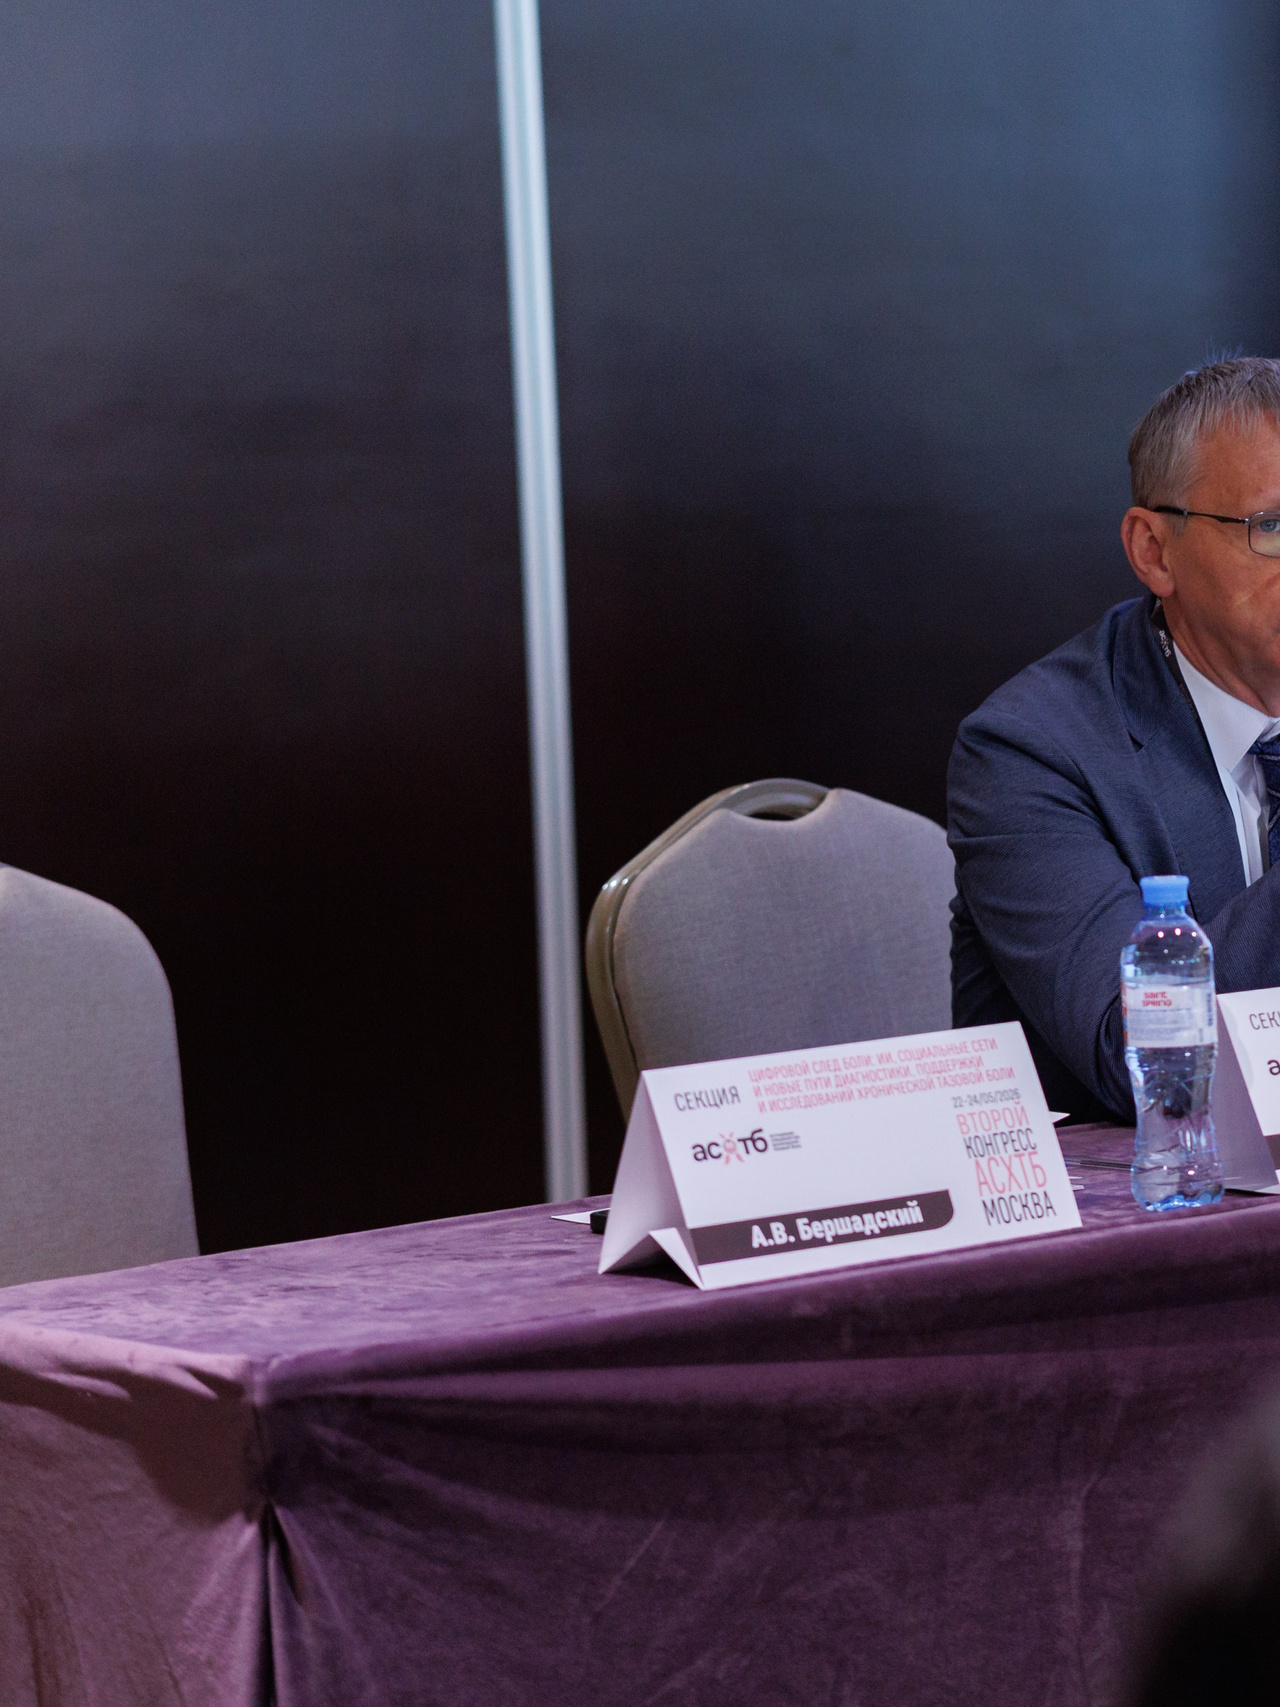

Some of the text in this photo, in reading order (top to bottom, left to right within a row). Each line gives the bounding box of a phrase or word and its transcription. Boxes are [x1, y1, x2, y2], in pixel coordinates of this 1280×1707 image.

[748, 1060, 810, 1082] ЦИФРОВОЙ
[812, 1058, 841, 1074] СЛЕД
[897, 1041, 969, 1062] СОЦИАЛЬНЫЕ
[971, 1037, 998, 1052] СЕТИ
[753, 1085, 762, 1097] И
[765, 1080, 801, 1096] НОВЫЕ
[804, 1076, 832, 1091] ПУТИ
[916, 1055, 984, 1075] ПОДДЕРЖКИ
[674, 1086, 741, 1112] СЕКЦИЯ
[757, 1067, 1015, 1113] И ИССЛЕДОВАНИЙ ХРОНИЧЕСКОЙ ТАЗОВОЙ БОЛИ
[951, 1088, 1021, 1108] 22-24/05/2026
[956, 1101, 1030, 1135] ВТОРОЙ
[963, 1128, 1037, 1159] КОНГРЕСС
[975, 1151, 1047, 1196] АСХТБ
[751, 1200, 924, 1249] А.В. Бершадский
[982, 1190, 1057, 1226] МОСКВА
